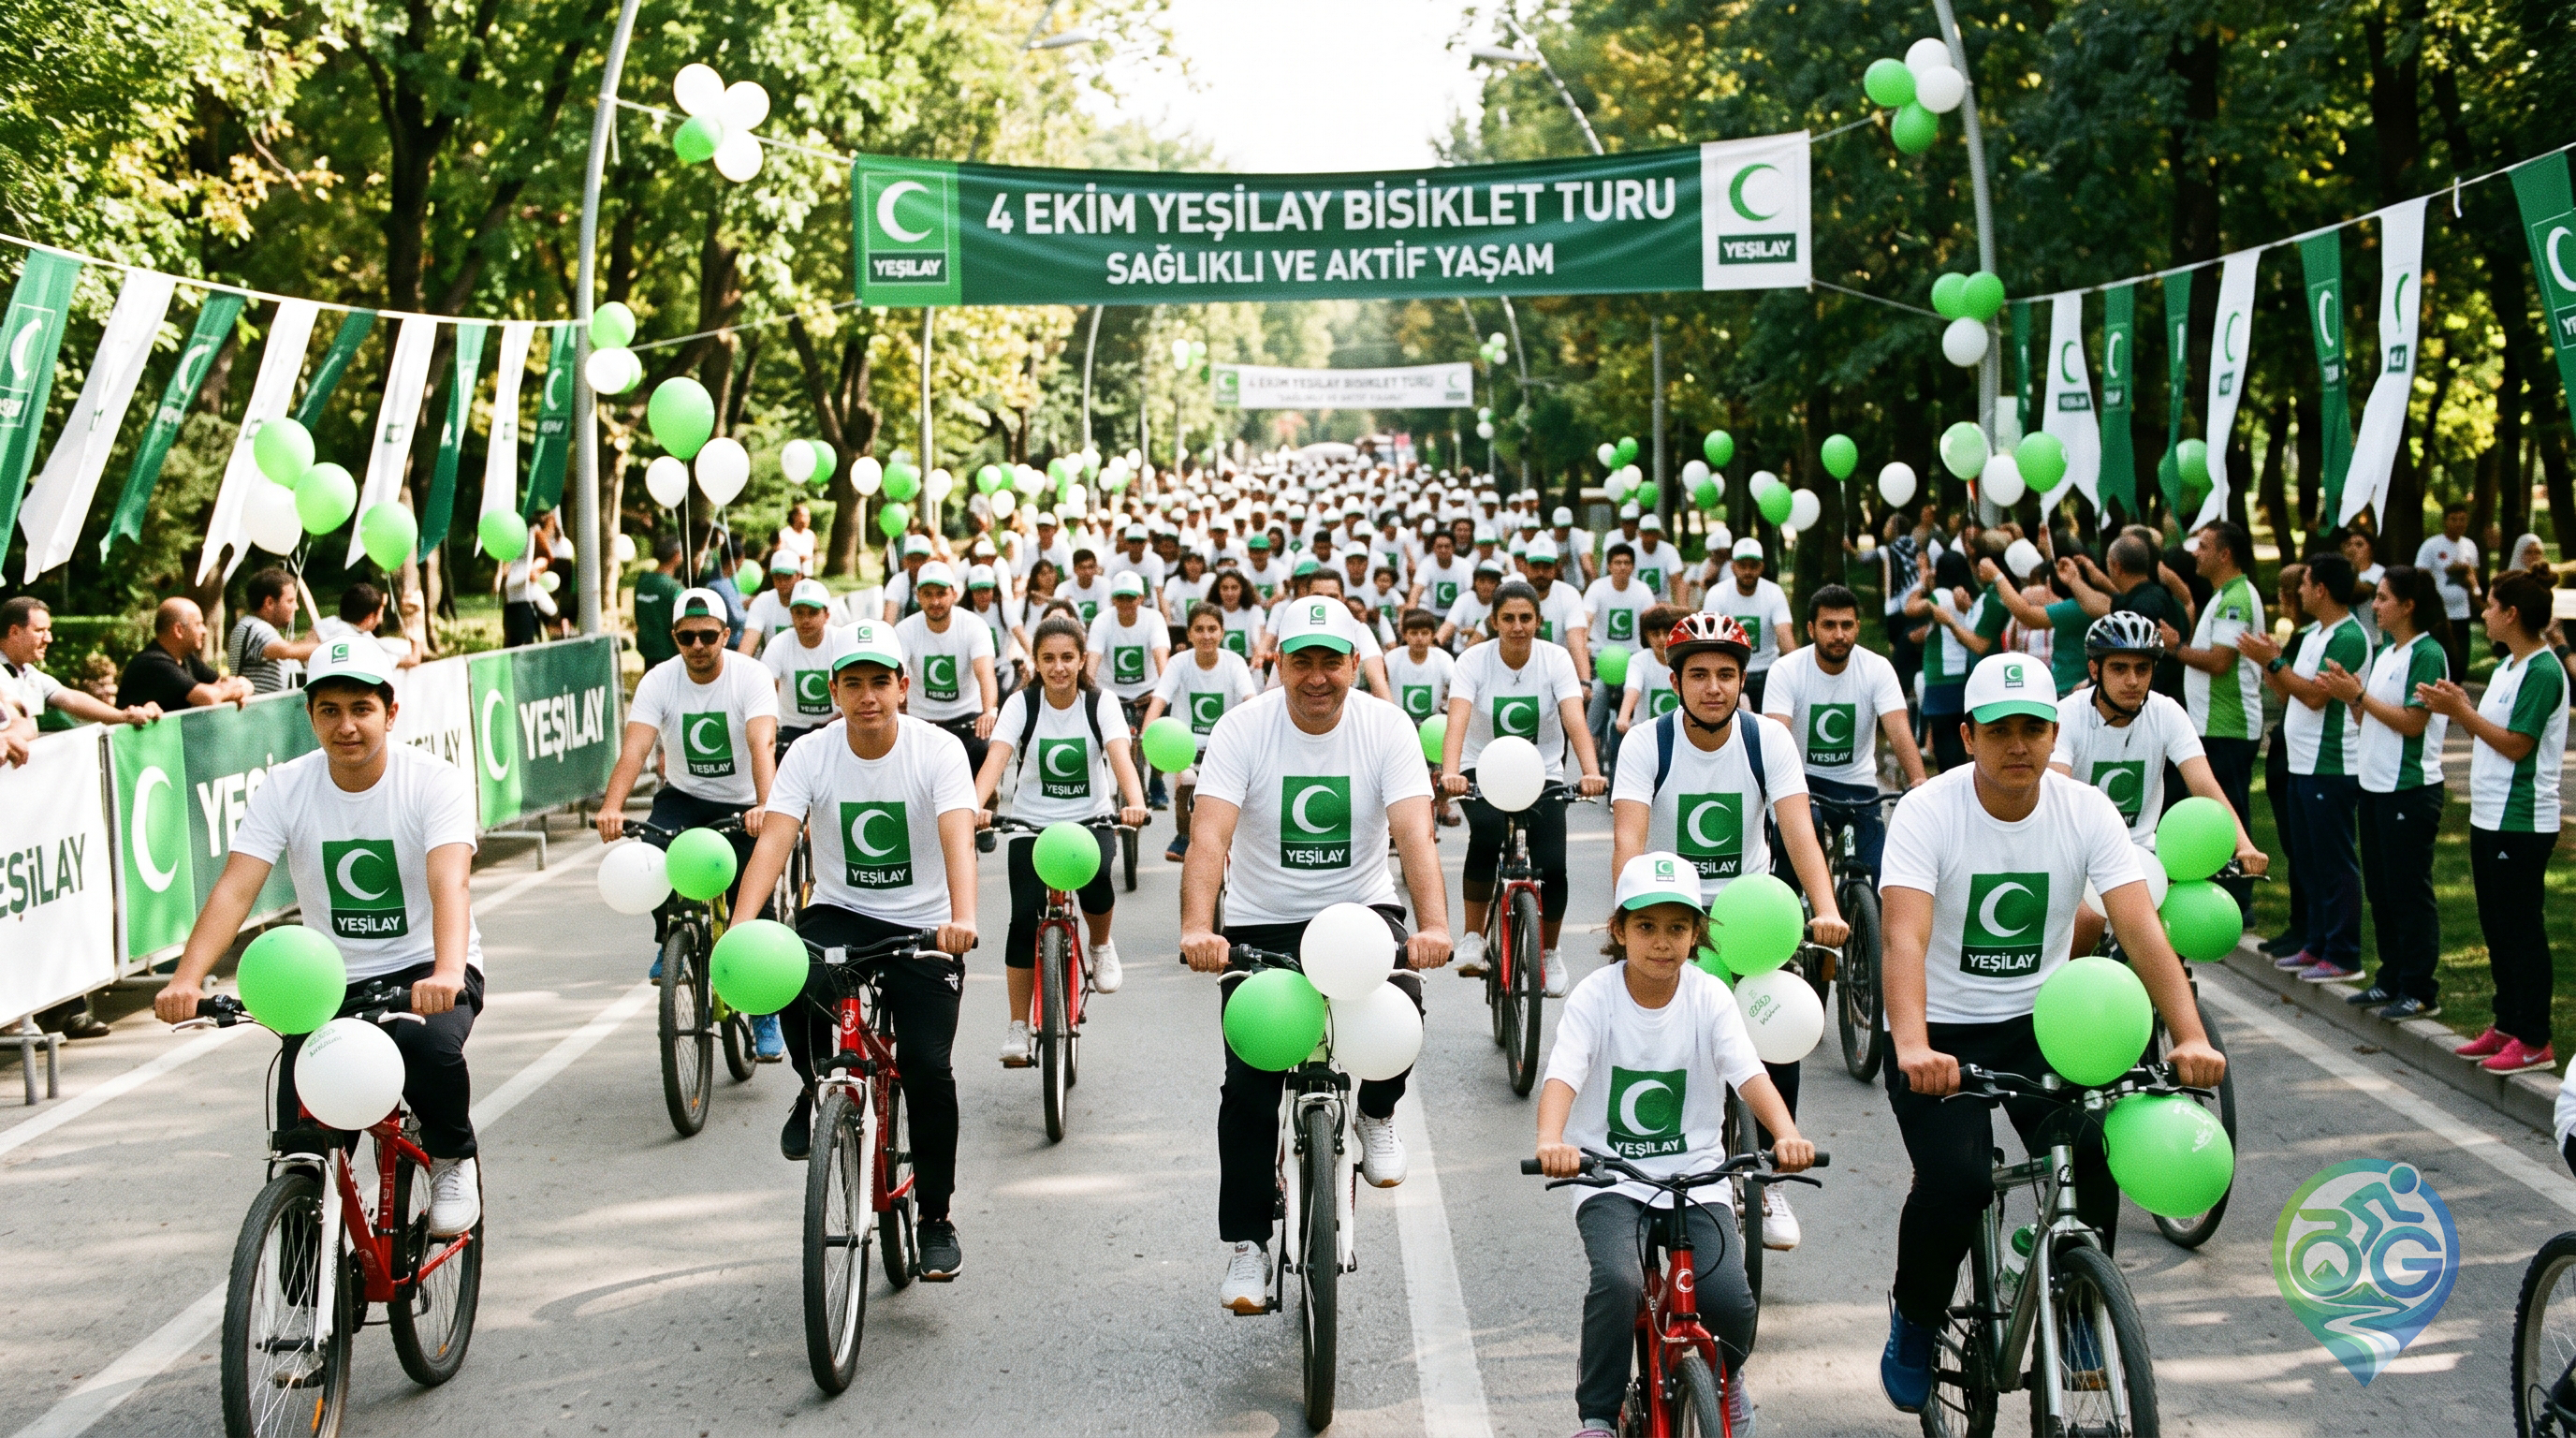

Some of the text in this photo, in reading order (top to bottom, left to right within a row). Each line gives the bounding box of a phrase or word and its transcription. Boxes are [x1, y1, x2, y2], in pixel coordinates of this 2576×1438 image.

[986, 177, 1676, 242] 4 EKİM YEŞİLAY BİSİKLET TURU
[1106, 240, 1554, 285] SAĞLIKLI VE AKTİF YAŞAM
[519, 684, 606, 763] YEŞİLAY
[1286, 847, 1346, 866] YEŞİLAY
[1692, 858, 1737, 874] EŞİLAY
[851, 869, 906, 886] YEŞİLAY
[337, 916, 401, 934] YEŞİLAY
[1968, 952, 2037, 973] YEŞİLAY
